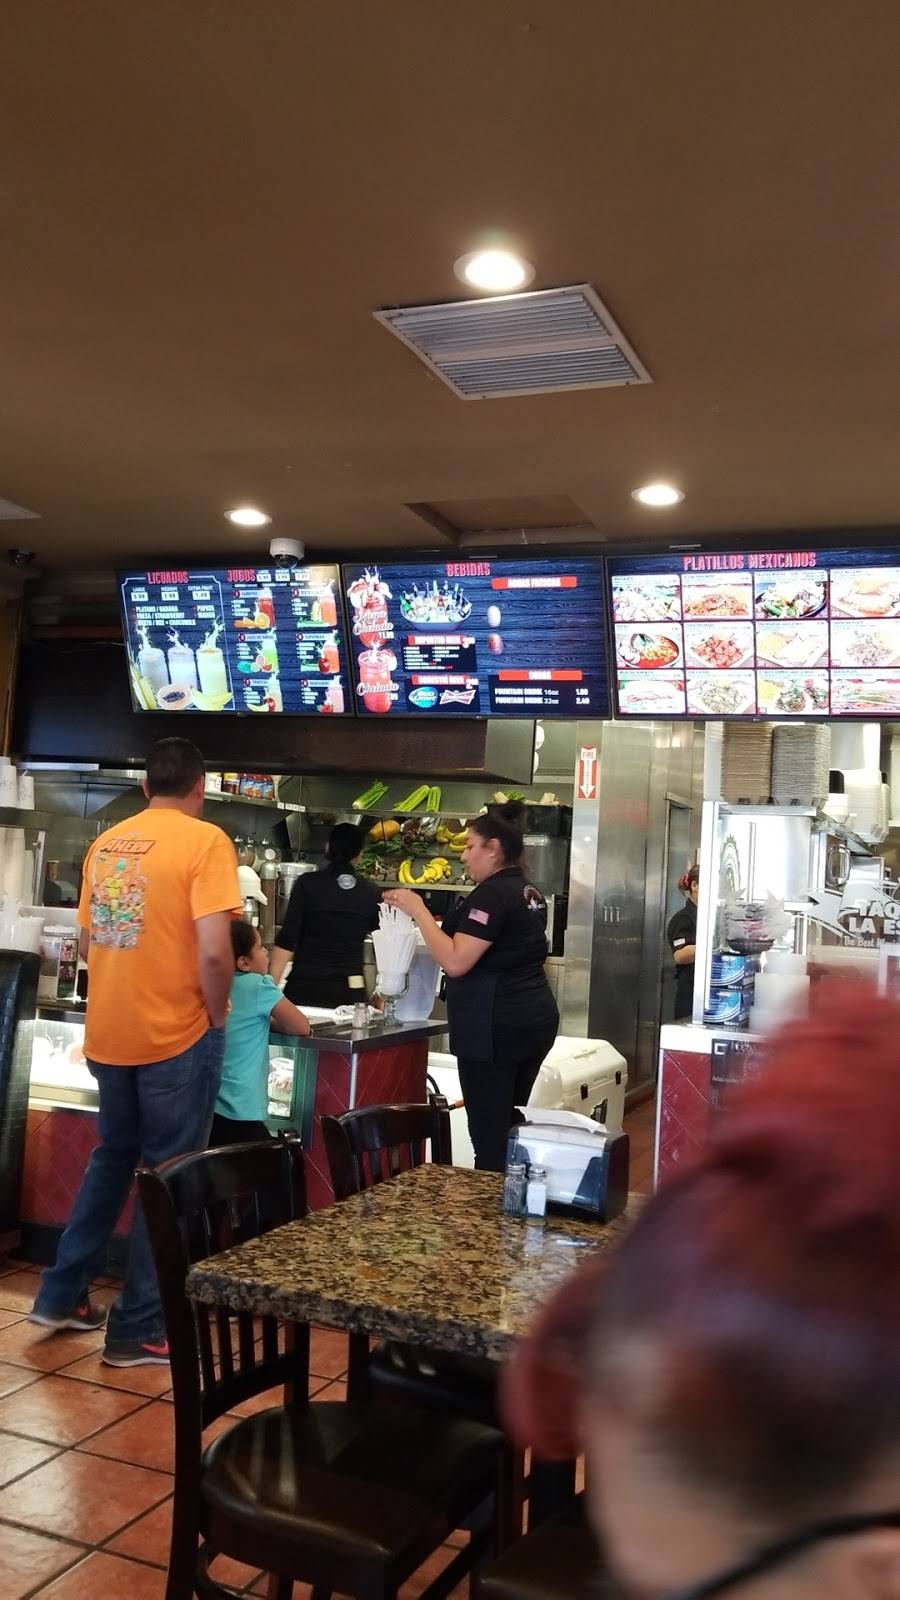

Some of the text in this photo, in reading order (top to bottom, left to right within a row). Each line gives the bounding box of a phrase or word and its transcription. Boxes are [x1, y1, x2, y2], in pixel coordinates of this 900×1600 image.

[683, 552, 816, 571] PLATILLOS MEXICANOS
[227, 569, 256, 582] JUGOS
[447, 562, 491, 577] BEBIDAS
[147, 571, 189, 585] LICUADOS
[494, 688, 523, 696] FOUNTAIN
[524, 688, 543, 696] DRINK
[583, 751, 594, 759] FIRE
[848, 917, 876, 934] LA
